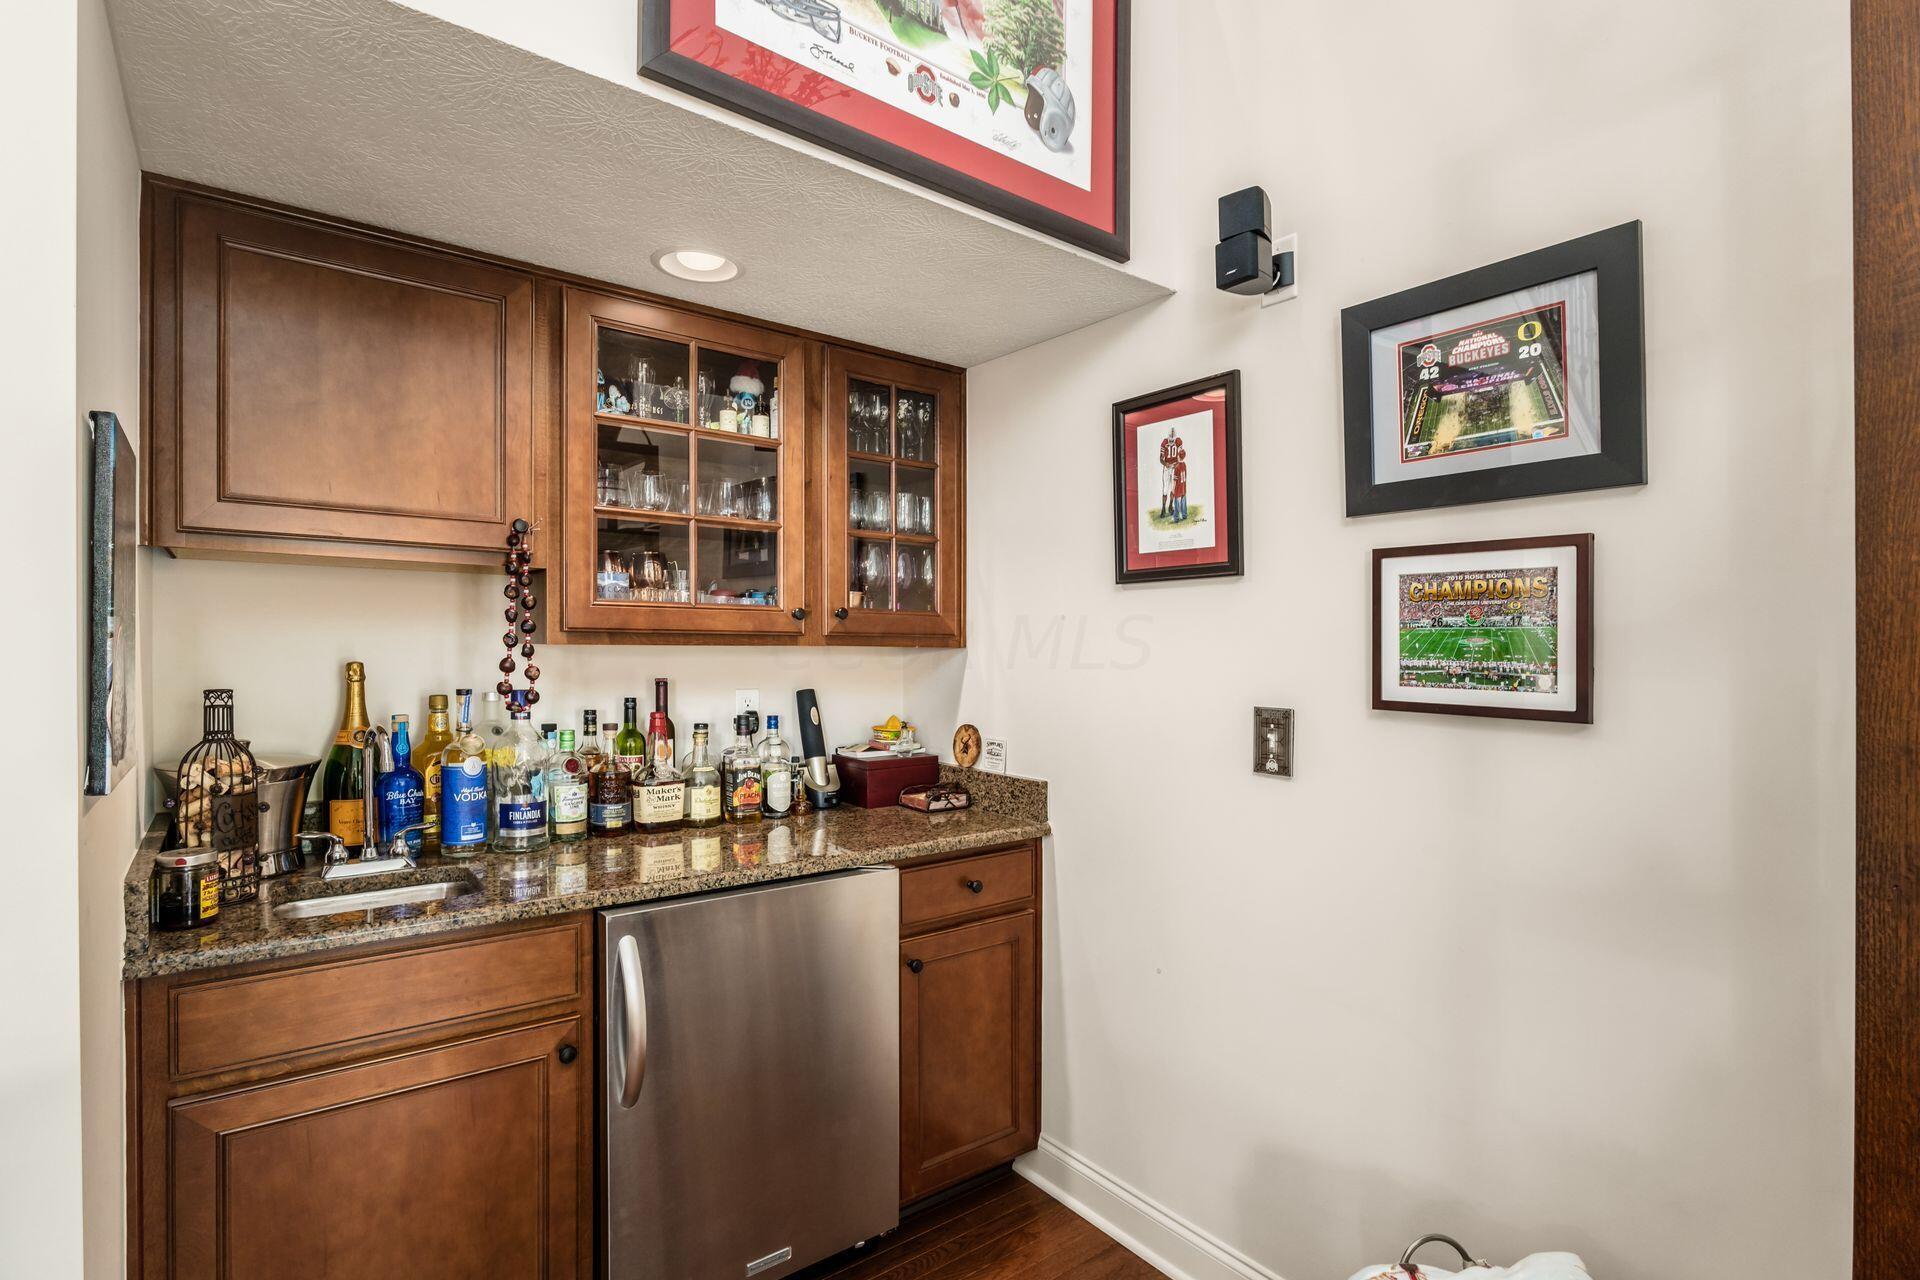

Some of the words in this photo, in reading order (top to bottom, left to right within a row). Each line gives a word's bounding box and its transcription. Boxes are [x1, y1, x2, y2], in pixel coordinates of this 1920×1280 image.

[1451, 336, 1506, 355] CHAMPIONS
[1458, 332, 1499, 347] NATIONAL
[1448, 342, 1510, 367] BUCKEYES
[1518, 342, 1542, 360] 20
[1419, 366, 1440, 381] 42
[1167, 445, 1177, 459] 10
[1409, 576, 1549, 603] CHAMPIONS
[1430, 617, 1443, 628] 26
[1509, 615, 1522, 626] 17
[736, 772, 748, 783] JIM
[385, 790, 407, 802] Blue
[453, 790, 487, 802] VODKA
[646, 786, 682, 796] Maker's
[739, 791, 760, 800] PEACH
[399, 797, 416, 805] BAY
[656, 793, 681, 803] Mark
[508, 809, 541, 821] FINLANDIA
